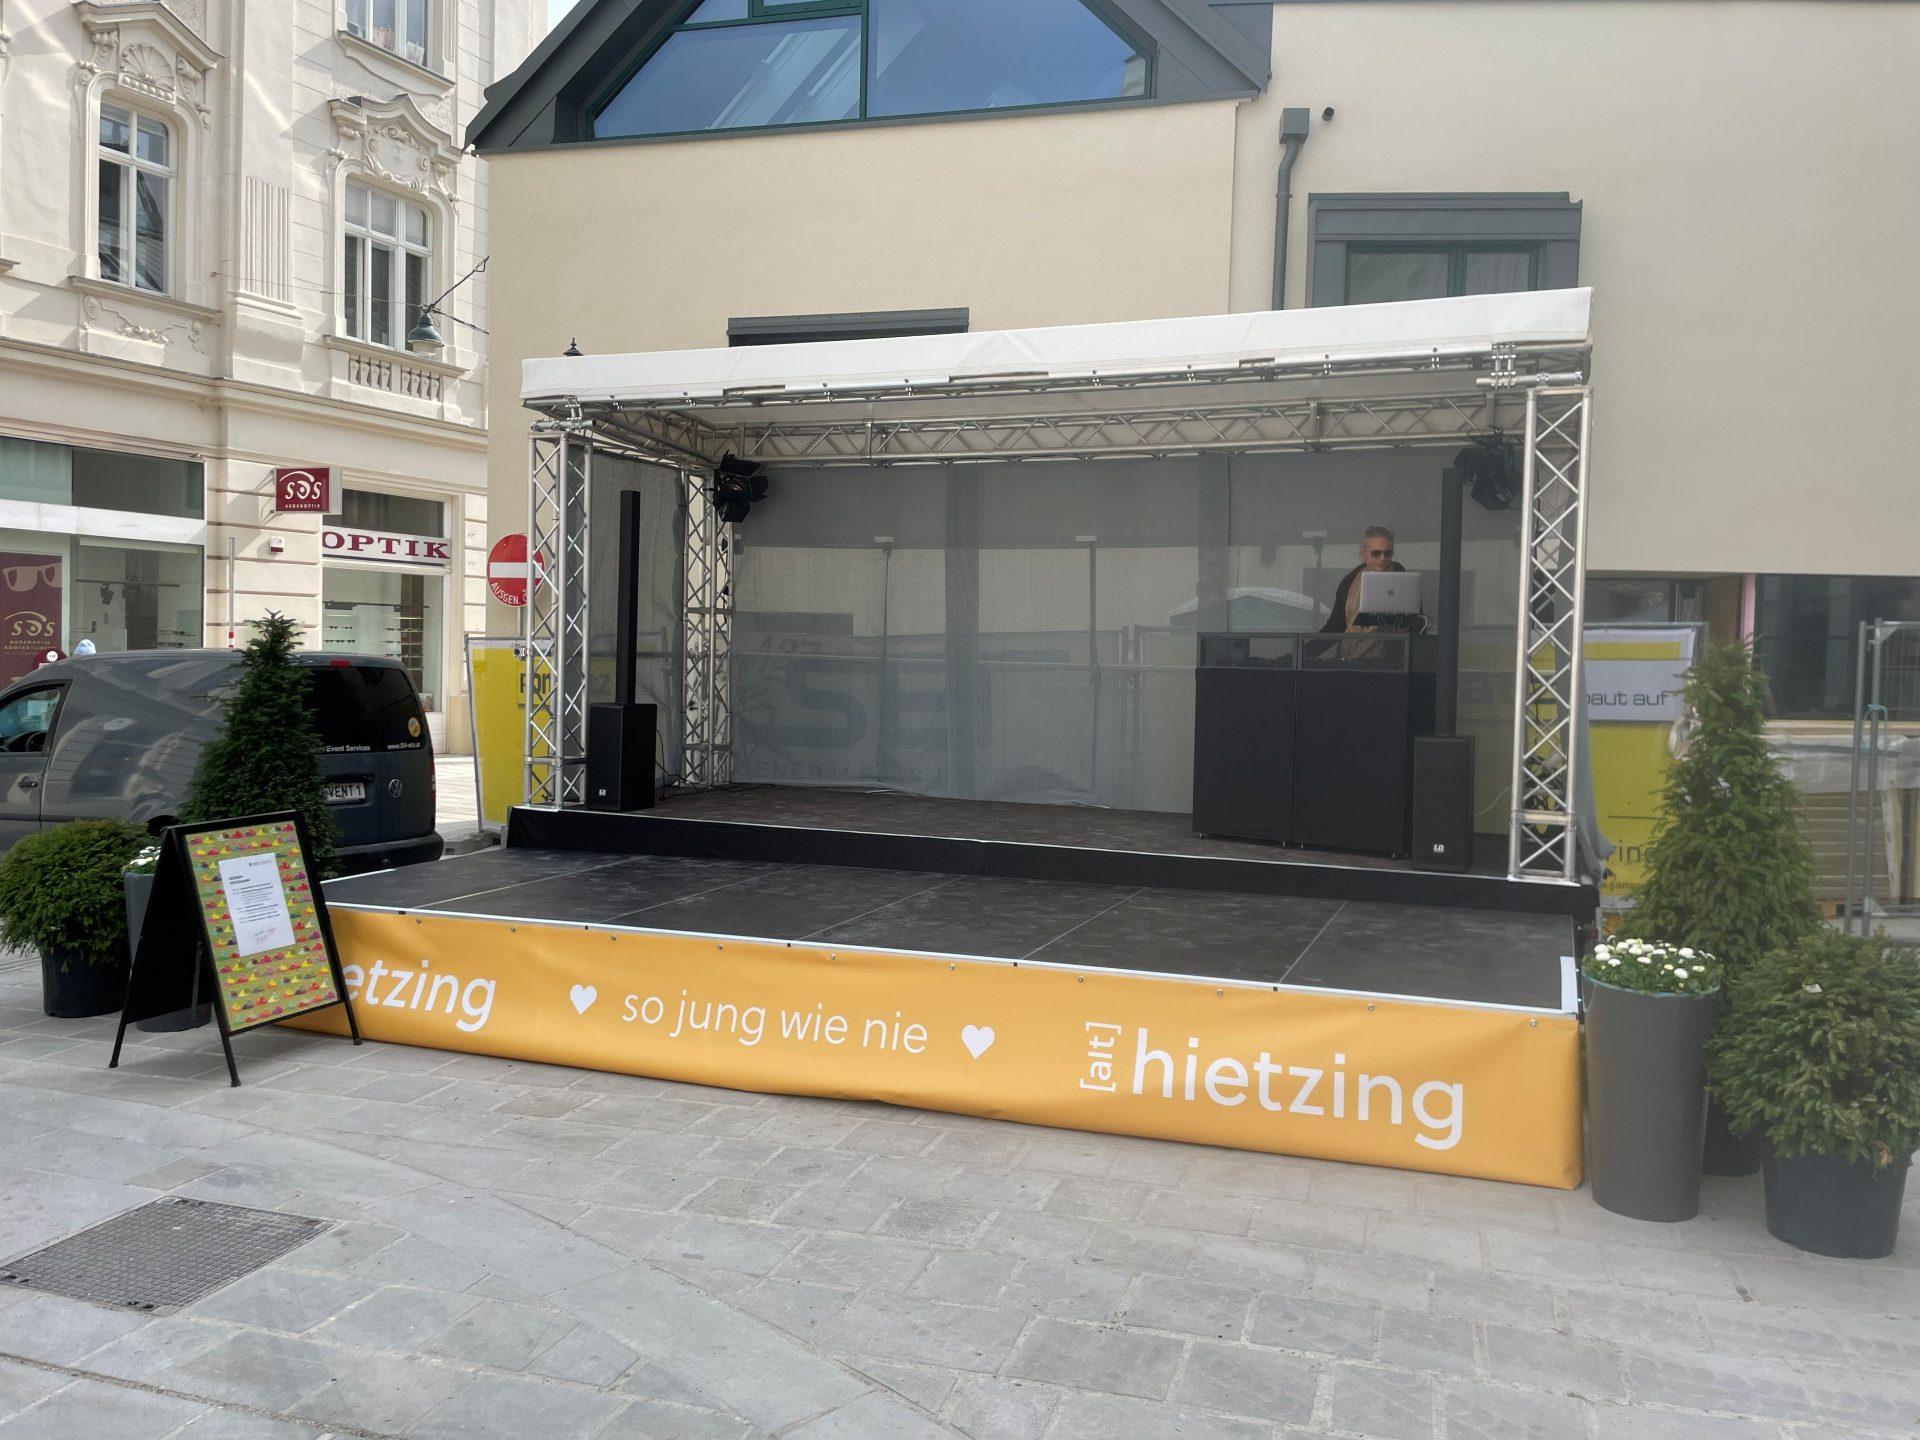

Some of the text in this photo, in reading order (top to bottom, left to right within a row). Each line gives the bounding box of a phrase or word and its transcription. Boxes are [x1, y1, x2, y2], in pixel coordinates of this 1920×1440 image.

[285, 480, 322, 500] SOS
[322, 531, 450, 560] OPTIK
[490, 581, 522, 605] AUSGEN.
[1633, 690, 1669, 706] auf
[345, 744, 371, 752] Services
[343, 959, 496, 1032] etzing
[622, 990, 928, 1054] so jung wie nie
[1079, 1021, 1122, 1093] [alt]
[1131, 1027, 1463, 1151] hietzing
